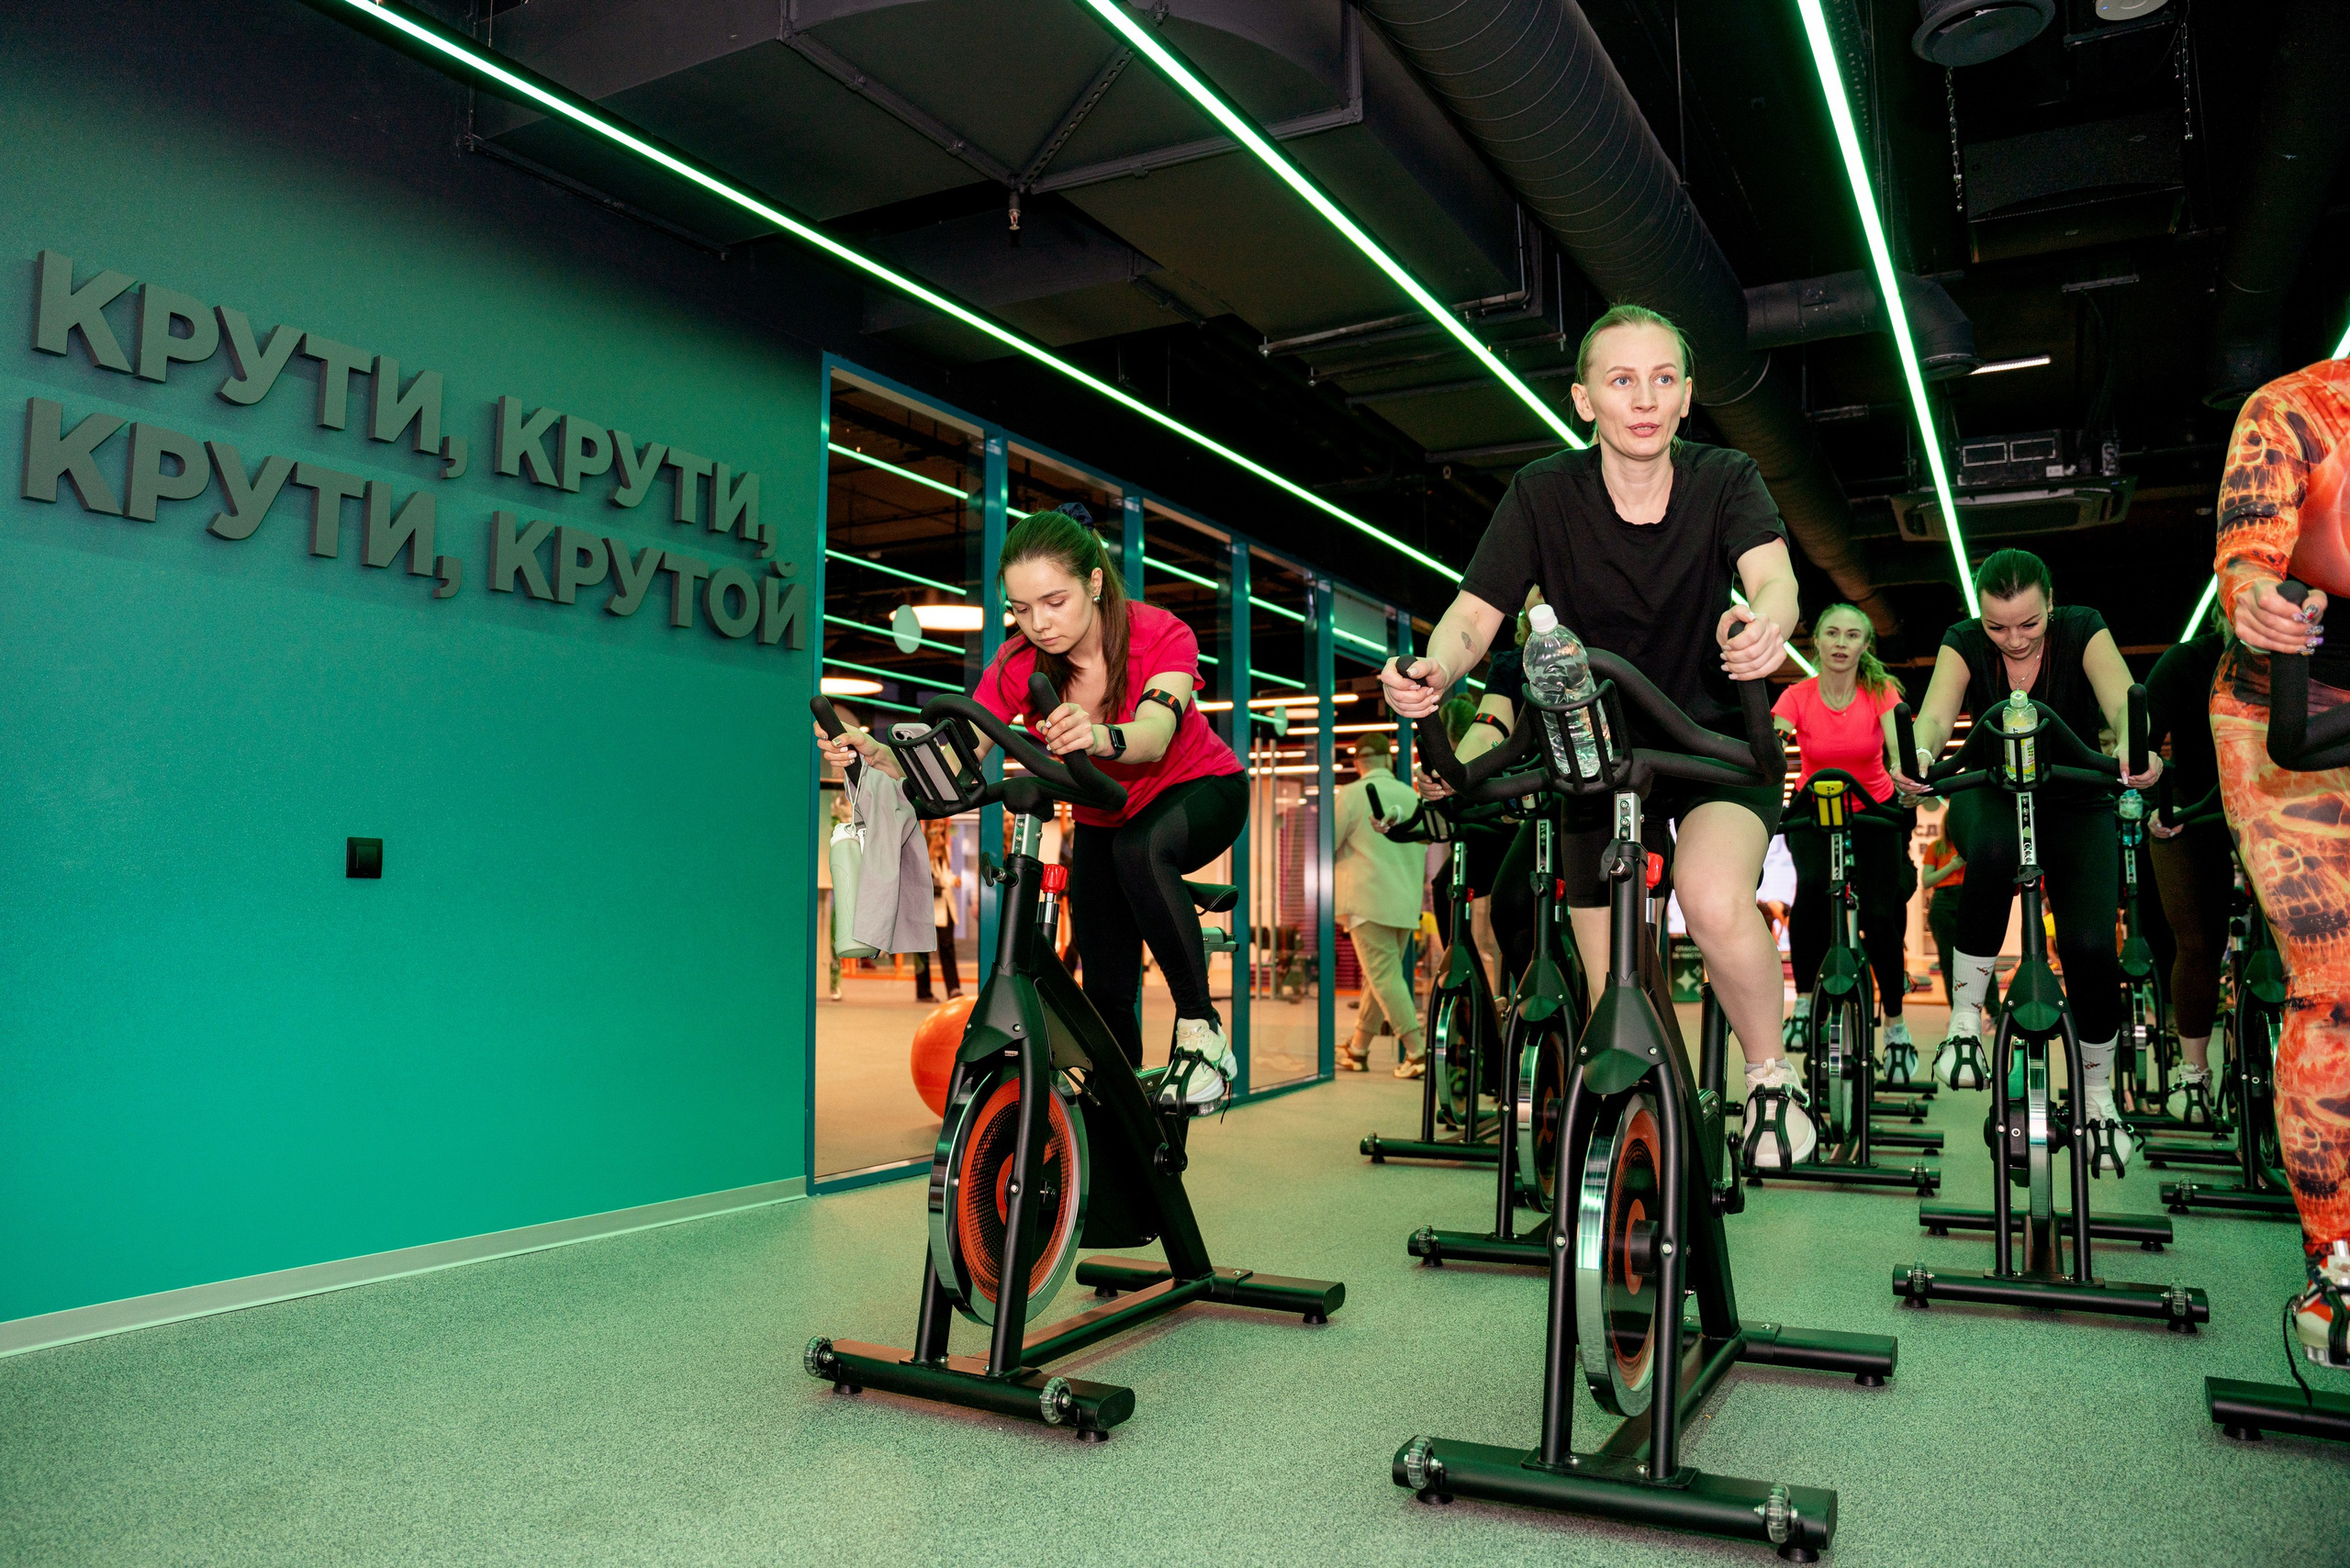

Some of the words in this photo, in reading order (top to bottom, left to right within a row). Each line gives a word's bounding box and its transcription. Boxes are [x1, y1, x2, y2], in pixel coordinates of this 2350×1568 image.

[20, 397, 464, 599] КРУТИ,
[488, 510, 807, 651] КРУТОЙ
[31, 249, 469, 479] КРУТИ,
[495, 395, 778, 559] КРУТИ,
